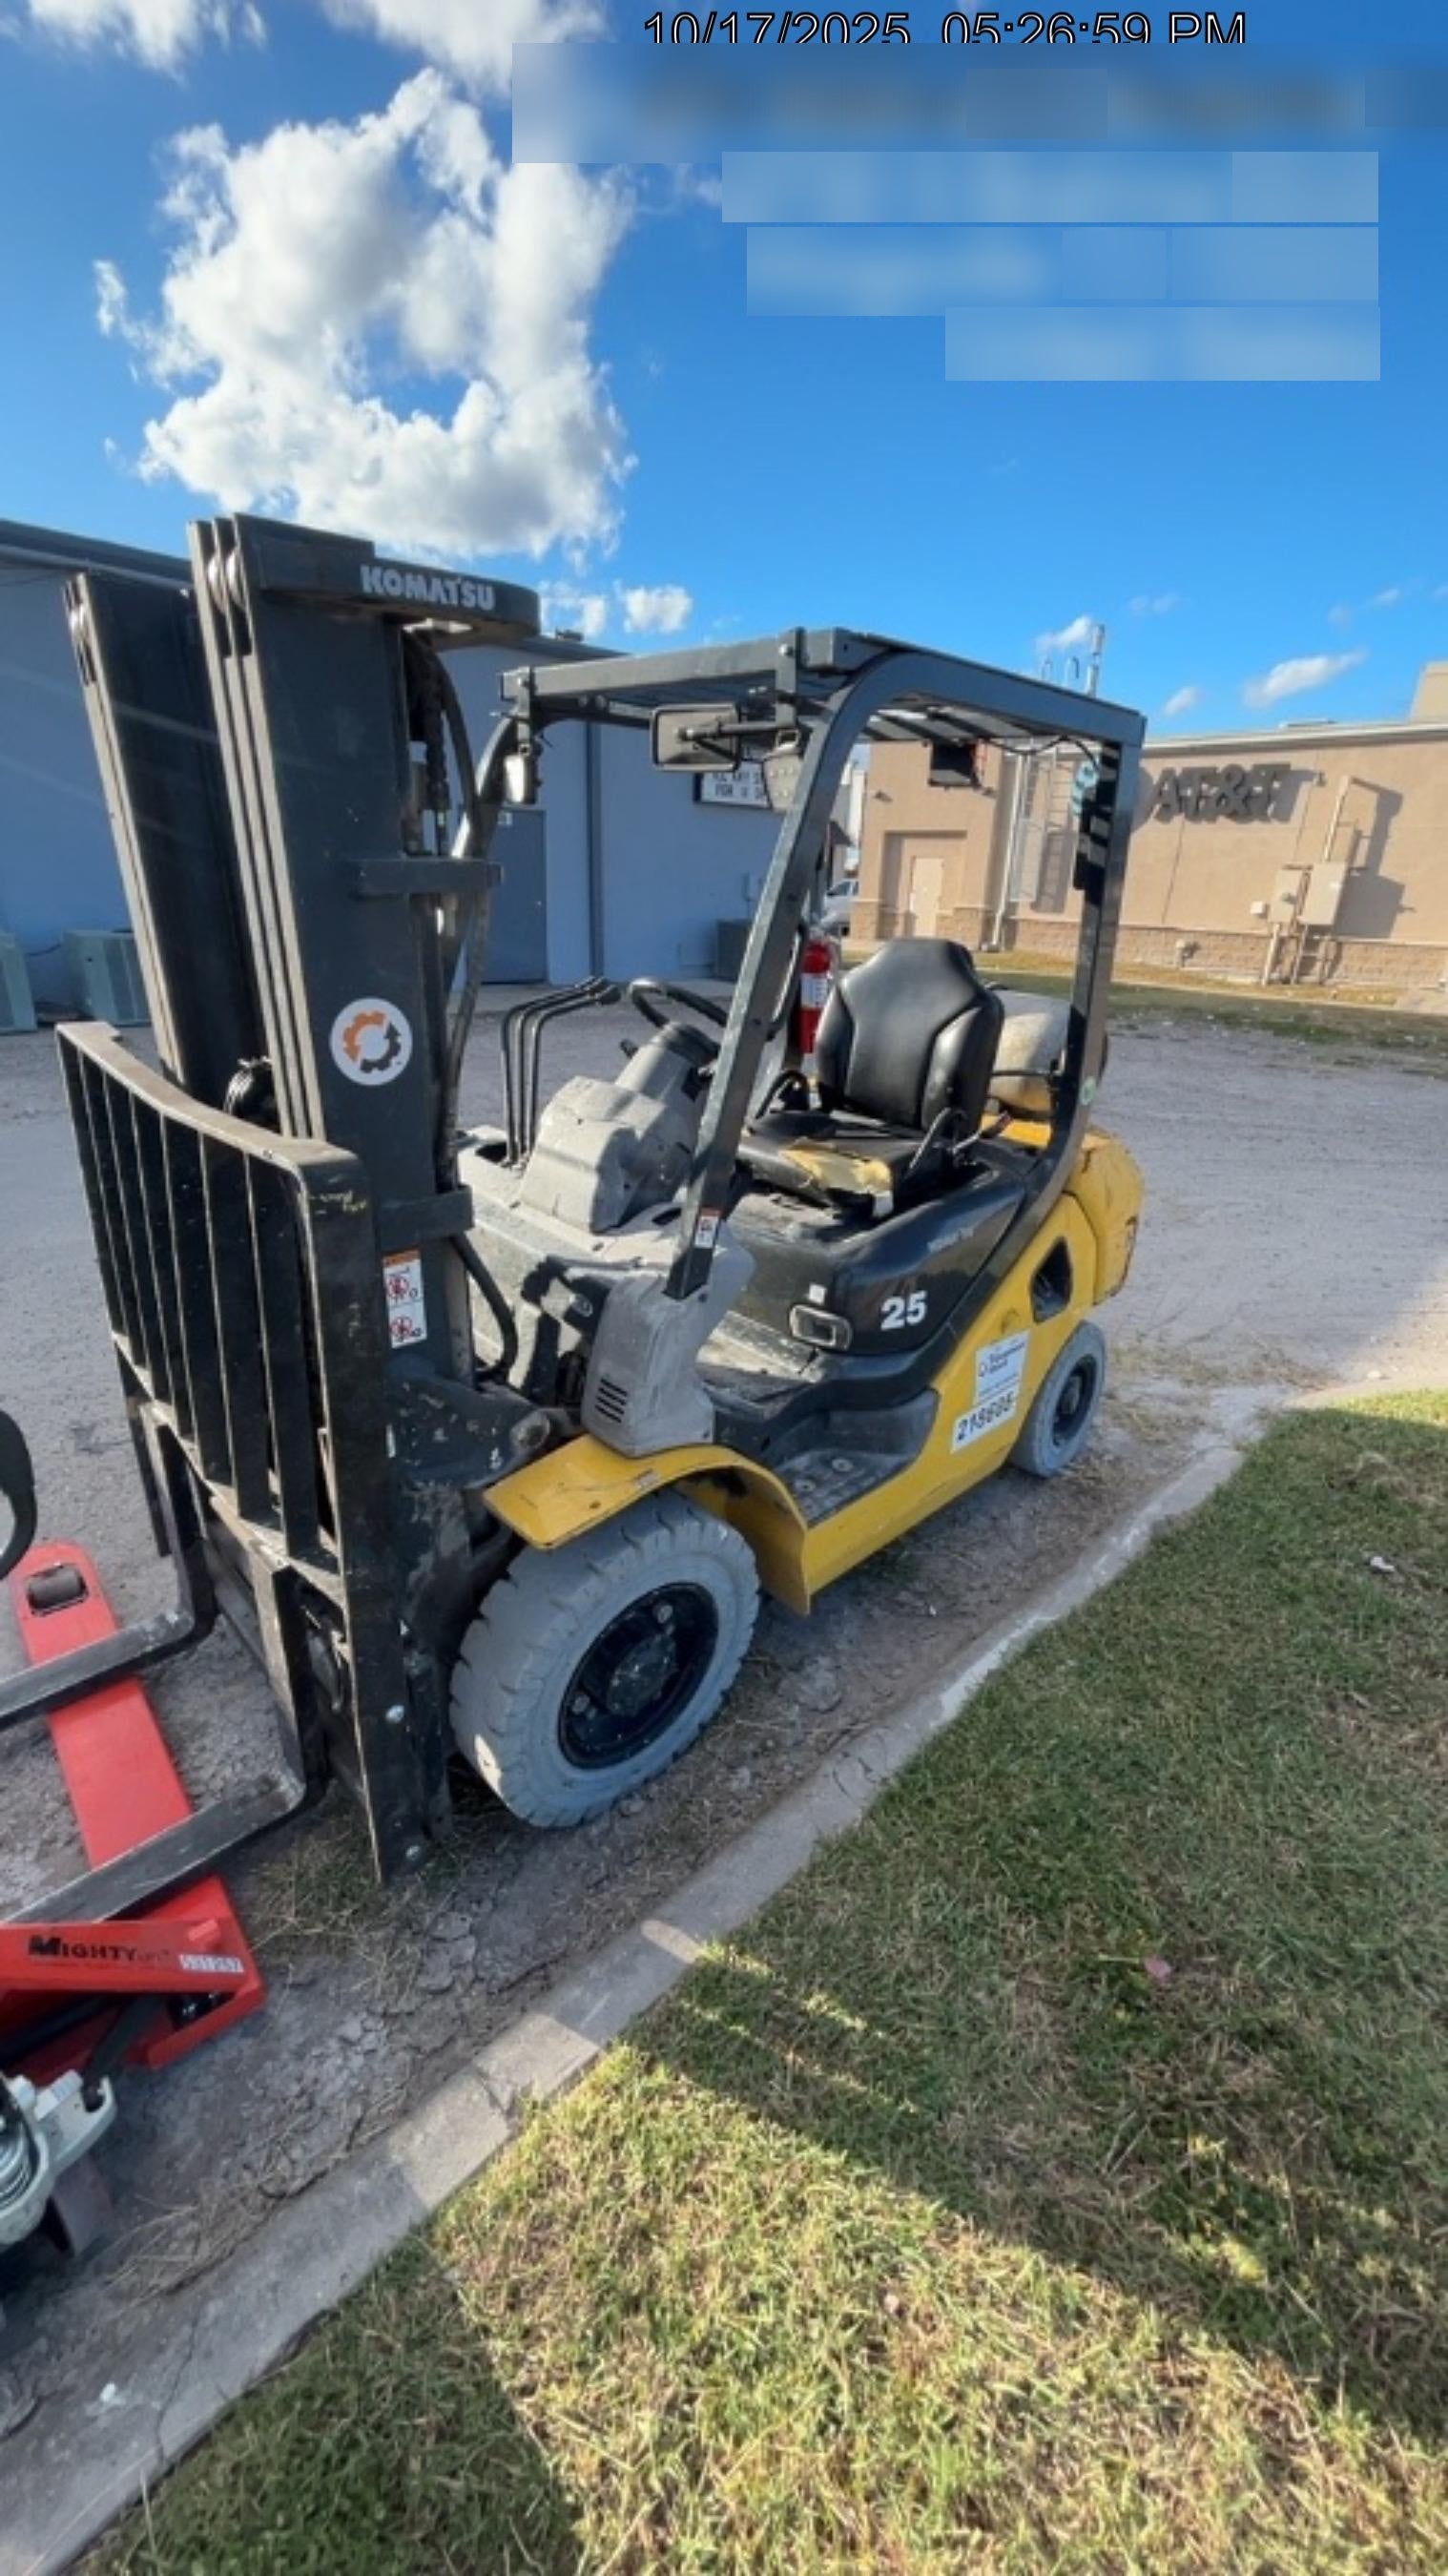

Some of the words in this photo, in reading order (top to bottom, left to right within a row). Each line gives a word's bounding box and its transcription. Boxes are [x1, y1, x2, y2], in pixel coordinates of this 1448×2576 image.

[360, 563, 496, 612] KOMATSU
[1151, 762, 1293, 825] AT&T
[879, 1289, 927, 1332] 25
